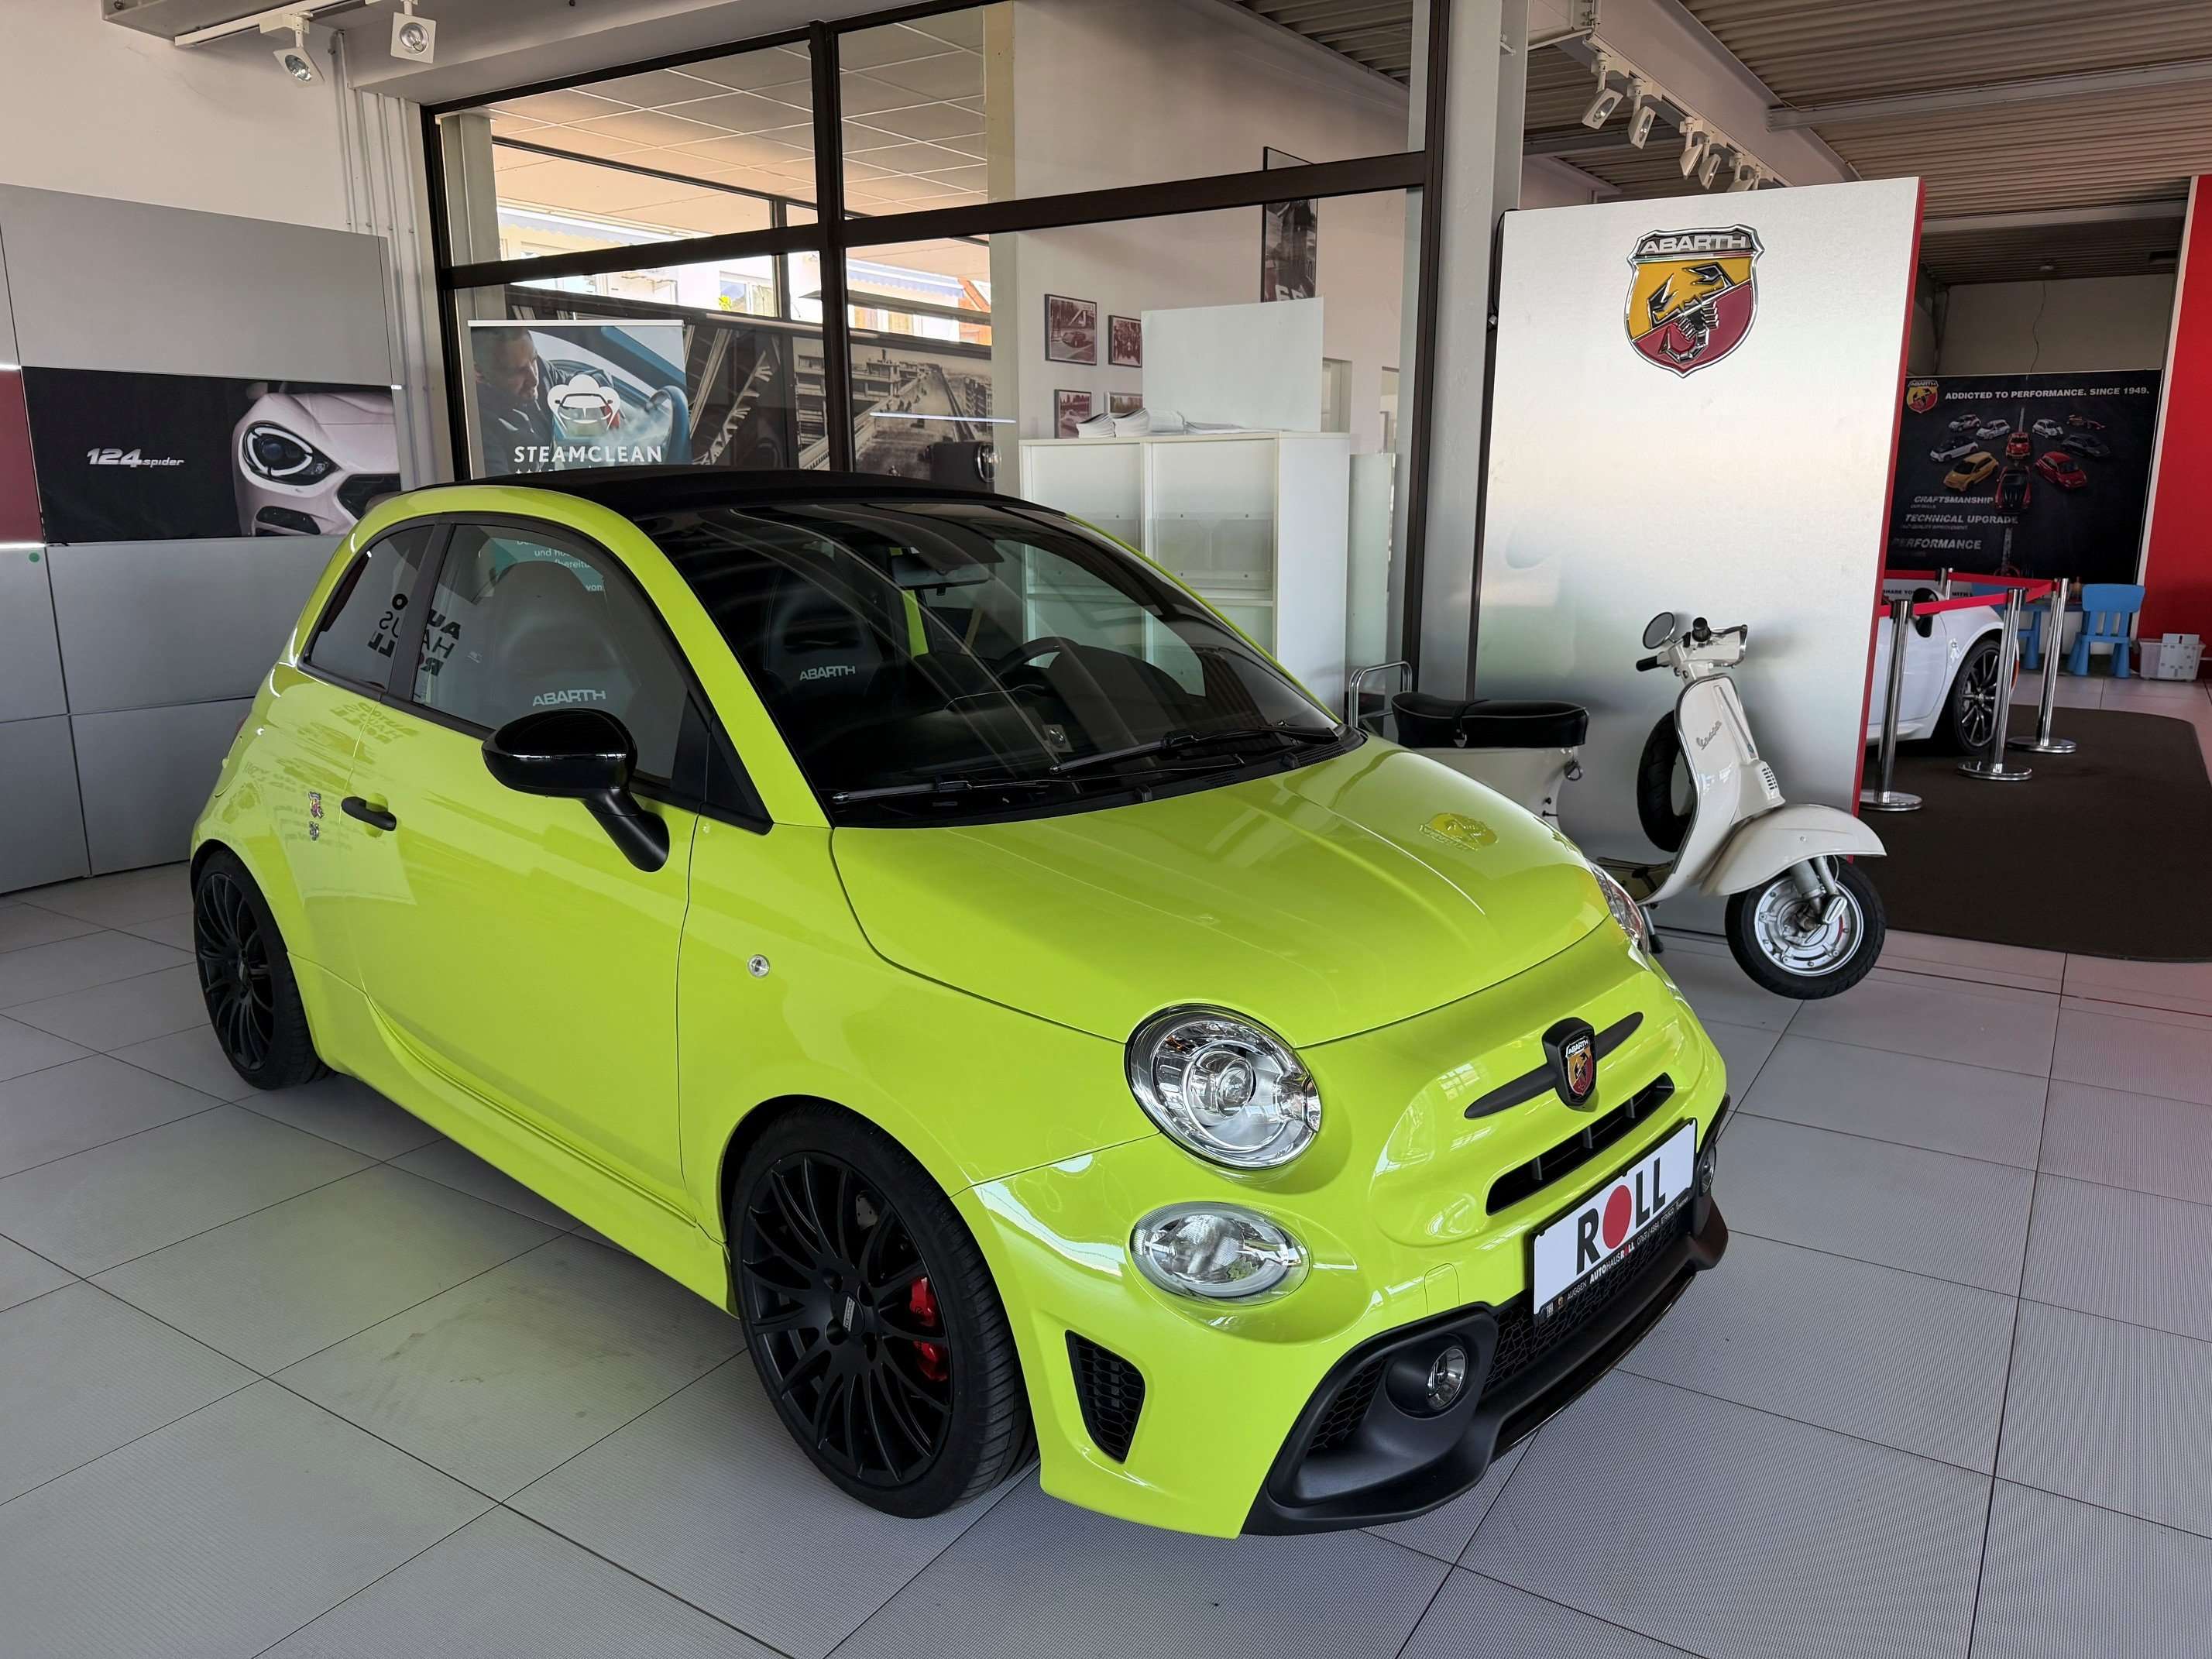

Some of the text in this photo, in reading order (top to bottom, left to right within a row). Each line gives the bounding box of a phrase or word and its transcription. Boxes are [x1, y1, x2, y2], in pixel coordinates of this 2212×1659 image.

[1641, 235, 1747, 253] ABARTH
[1945, 391, 1993, 400] ADDICTED
[2011, 388, 2087, 398] PERFORMANCE.
[2090, 387, 2121, 396] SINCE
[2123, 386, 2150, 395] 1949.
[514, 445, 663, 463] STEAMCLEAN
[1914, 496, 1994, 504] CRAFTSMANSHIP
[1905, 514, 2019, 524] TECHNICAL UPGRADE
[1891, 537, 1983, 550] PERFORMANCE
[534, 548, 551, 557] und
[799, 665, 856, 681] ABARTH
[532, 689, 606, 707] ABARTH
[1695, 720, 1723, 750] Vespa
[1568, 1039, 1589, 1055] ABARTH
[1576, 1157, 1666, 1276] ROLL
[1567, 1279, 1587, 1300] AUGGEN
